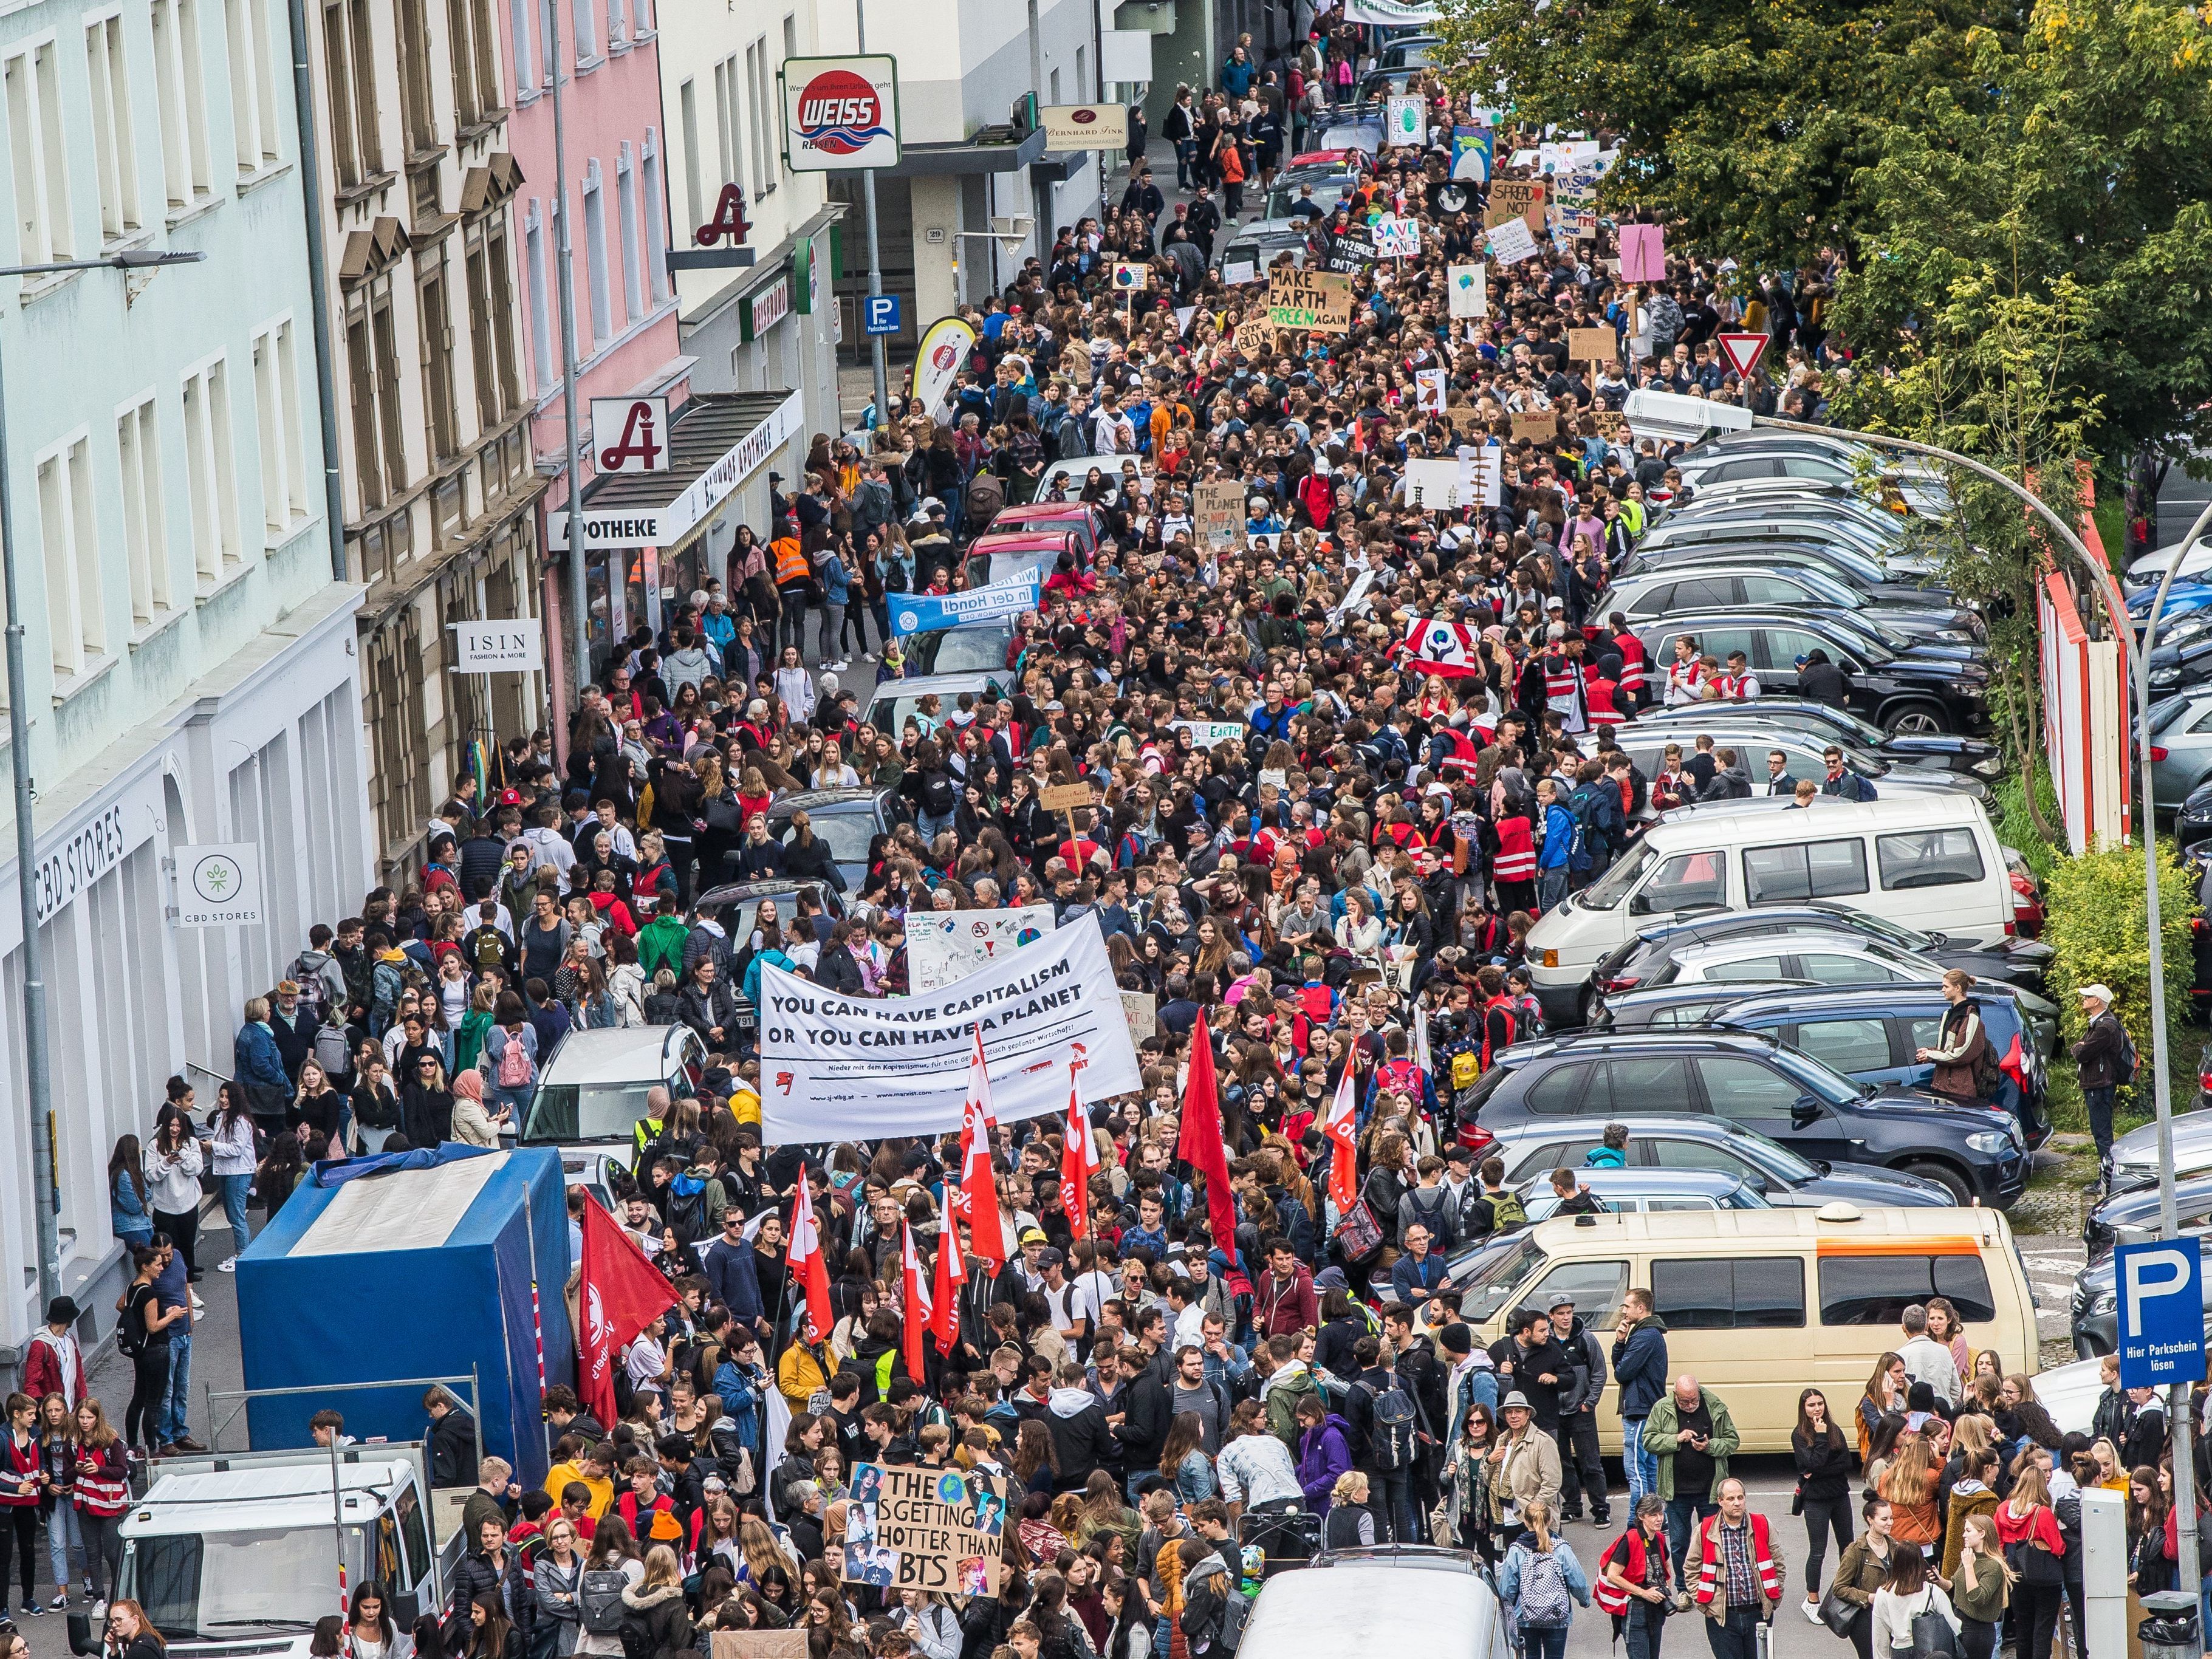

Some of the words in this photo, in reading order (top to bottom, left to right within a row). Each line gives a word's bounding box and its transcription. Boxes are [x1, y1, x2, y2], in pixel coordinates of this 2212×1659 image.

[803, 97, 875, 128] WEISS
[1046, 128, 1098, 137] BERNHARD
[802, 139, 837, 150] REISEN
[1493, 185, 1535, 201] SPREAD
[1507, 201, 1532, 214] NOT
[930, 230, 941, 238] 29
[1375, 222, 1416, 240] SAVE
[1564, 226, 1581, 234] TOO
[1336, 237, 1348, 250] I'M
[1354, 242, 1376, 258] BROKE
[1330, 258, 1344, 270] ON
[1345, 261, 1363, 275] THE
[1271, 269, 1313, 289] MAKE
[753, 284, 786, 333] REISEBÜRO
[1270, 289, 1327, 310] EARTH
[1269, 307, 1315, 327] GREEN
[1314, 313, 1347, 326] AGAIN
[1239, 328, 1275, 350] BILDUNG
[937, 346, 952, 369] WEISS
[1604, 414, 1621, 423] SURE
[739, 422, 772, 478] APOTHEKE
[1195, 487, 1219, 499] THE
[1206, 498, 1244, 510] PLANET
[1198, 513, 1208, 524] IS
[1210, 511, 1227, 523] NOT
[469, 634, 526, 651] ISIN
[1210, 725, 1241, 737] EARTH
[35, 855, 62, 921] CBD
[67, 805, 122, 895] STORES
[185, 914, 208, 923] CBD
[213, 912, 256, 921] STORES
[770, 996, 815, 1014] YOU
[821, 1001, 868, 1017] CAN
[875, 1008, 936, 1022] HAVE
[943, 958, 1070, 1016] CAPITALISM
[769, 1027, 796, 1044] OR
[806, 1029, 852, 1046] YOU
[858, 1030, 906, 1047] CAN
[913, 1021, 976, 1045] HAVE
[981, 1018, 998, 1033] A
[1002, 983, 1082, 1025] PLANET
[883, 1063, 930, 1072] Kapitalismus,
[1007, 1037, 1036, 1052] geplante
[1037, 1024, 1074, 1041] Wirtschaft!
[876, 1090, 932, 1099] www.marxist.com
[2125, 1250, 2191, 1337] P
[2127, 1347, 2145, 1359] Hier
[2149, 1340, 2197, 1356] Parkschein
[2151, 1360, 2174, 1372] lösen
[844, 1422, 860, 1439] VANS
[888, 1471, 937, 1500] THE
[876, 1499, 892, 1521] IS
[894, 1500, 975, 1528] GETTING
[877, 1525, 952, 1551] HOTTER
[957, 1533, 1001, 1557] THAN
[899, 1551, 948, 1587] BTS
